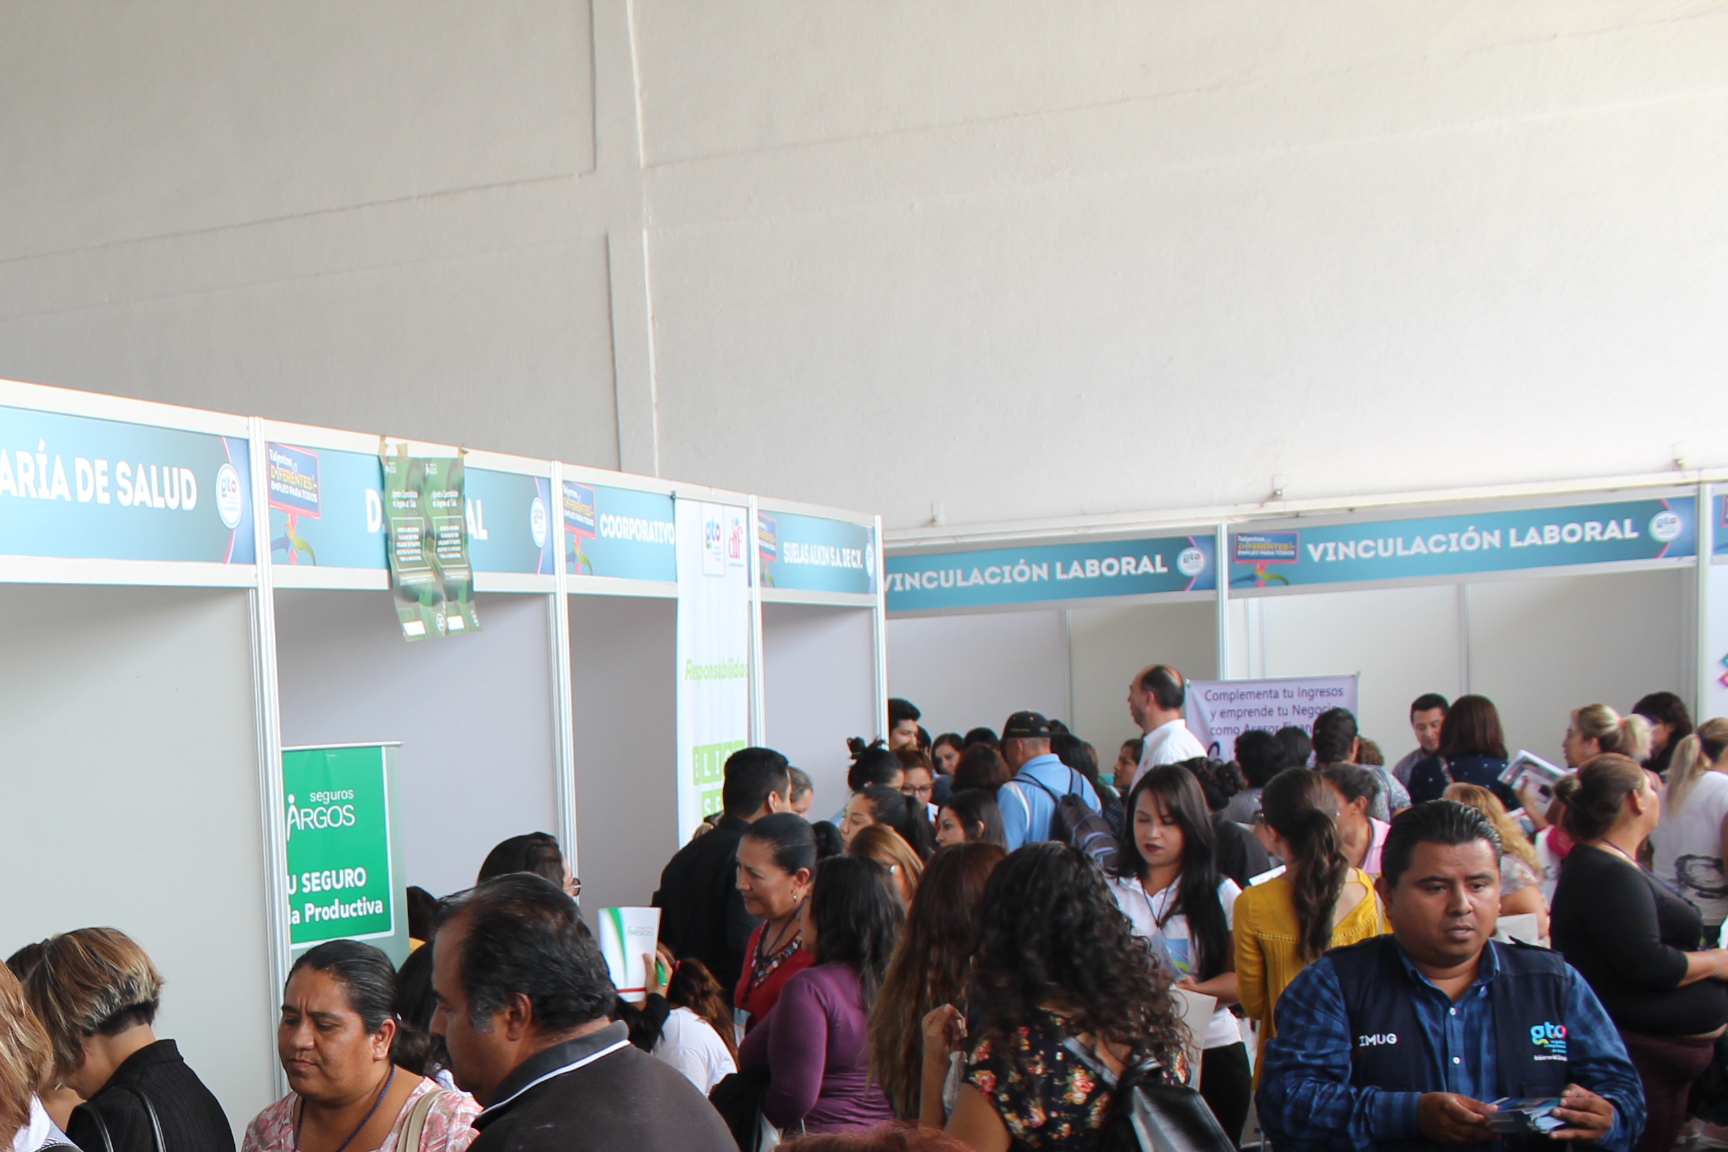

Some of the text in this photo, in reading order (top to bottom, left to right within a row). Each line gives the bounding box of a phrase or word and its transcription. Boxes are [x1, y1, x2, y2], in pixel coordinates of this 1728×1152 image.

[74, 457, 110, 505] DE
[116, 460, 197, 511] SALUD
[1307, 519, 1640, 563] VINCULACIÓN LABORAL
[885, 554, 1169, 591] VINCULACIÓN LABORAL
[1204, 686, 1344, 702] Complementa tu Ingresos
[1210, 704, 1337, 721] y emprende tu Negoci
[1210, 725, 1240, 735] como
[310, 789, 354, 805] seguros
[301, 866, 367, 893] SEGURO
[305, 896, 383, 923] Productiva
[1359, 1033, 1398, 1047] IMUG
[1531, 1021, 1568, 1046] gto
